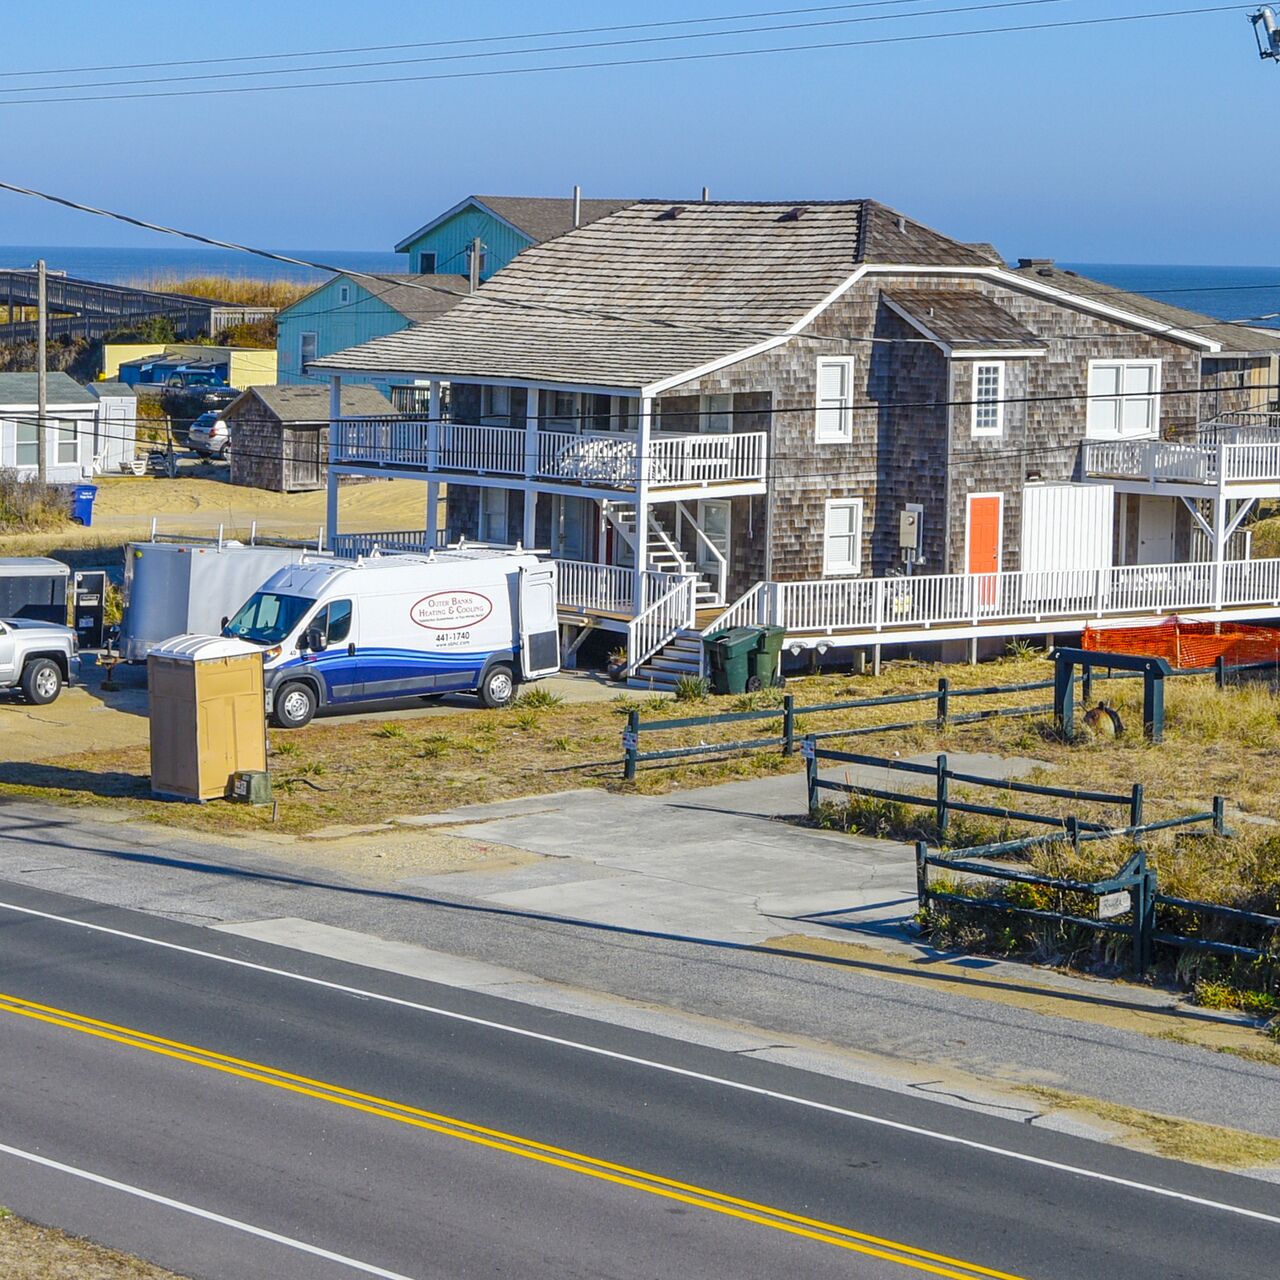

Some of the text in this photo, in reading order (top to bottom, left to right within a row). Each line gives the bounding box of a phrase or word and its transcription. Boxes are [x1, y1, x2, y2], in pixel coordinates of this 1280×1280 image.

[451, 597, 473, 606] BANKS
[419, 605, 484, 617] HEATING & COOLING
[436, 631, 470, 642] 441-1740
